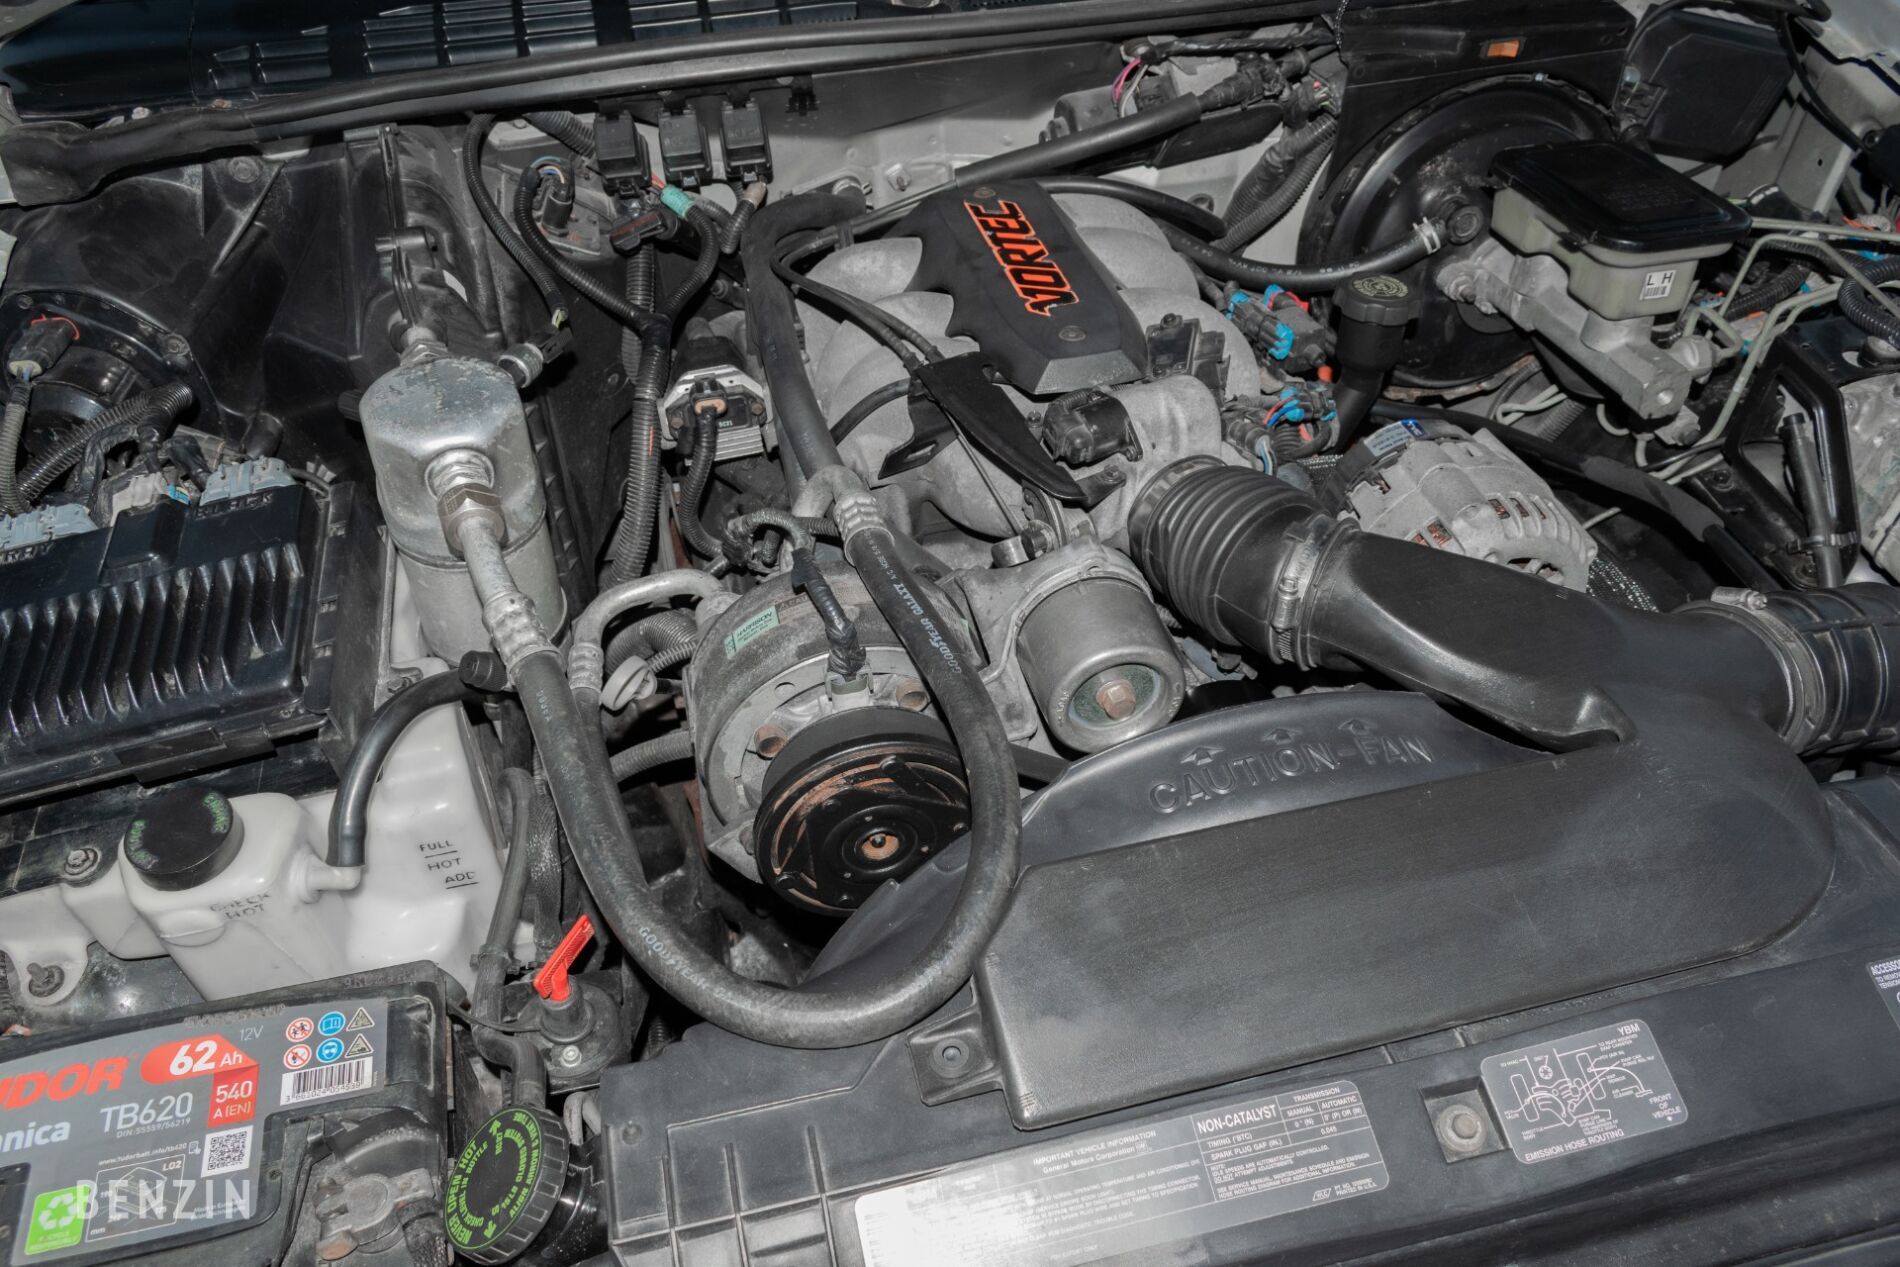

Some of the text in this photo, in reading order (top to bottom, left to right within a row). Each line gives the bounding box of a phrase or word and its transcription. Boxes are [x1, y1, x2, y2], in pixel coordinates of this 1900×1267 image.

[964, 200, 1079, 317] VORTEC
[893, 582, 922, 617] GALAXY
[921, 617, 962, 675] GOODYEAR
[419, 840, 454, 853] FULL
[428, 857, 462, 871] HOT
[239, 1025, 264, 1042] 12V
[1618, 1024, 1640, 1035] YBM
[169, 1039, 244, 1076] 62 Ah
[215, 1080, 253, 1104] 540
[1293, 1087, 1340, 1102] TRANSMISSION
[1649, 1094, 1672, 1104] FRONT
[100, 1092, 194, 1133] TB620
[213, 1102, 251, 1119] A (EN)
[1287, 1096, 1357, 1116] MANUAL AUTOMATIC
[1652, 1107, 1681, 1119] VEHICLE
[1197, 1105, 1277, 1134] NON-CATALYST
[0, 1121, 71, 1151] nica
[1033, 1131, 1156, 1165] IMPORTANT VEHICLE INFORMATION
[1208, 1138, 1230, 1147] TIMING
[1525, 1130, 1624, 1161] EMISSION HOSE ROUTING
[1043, 1162, 1069, 1173] General
[1096, 1147, 1134, 1161] Corporation
[1211, 1149, 1233, 1161] SPARK
[1234, 1145, 1252, 1157] PLUG
[448, 1140, 477, 1245] NEVER OPEN HOT
